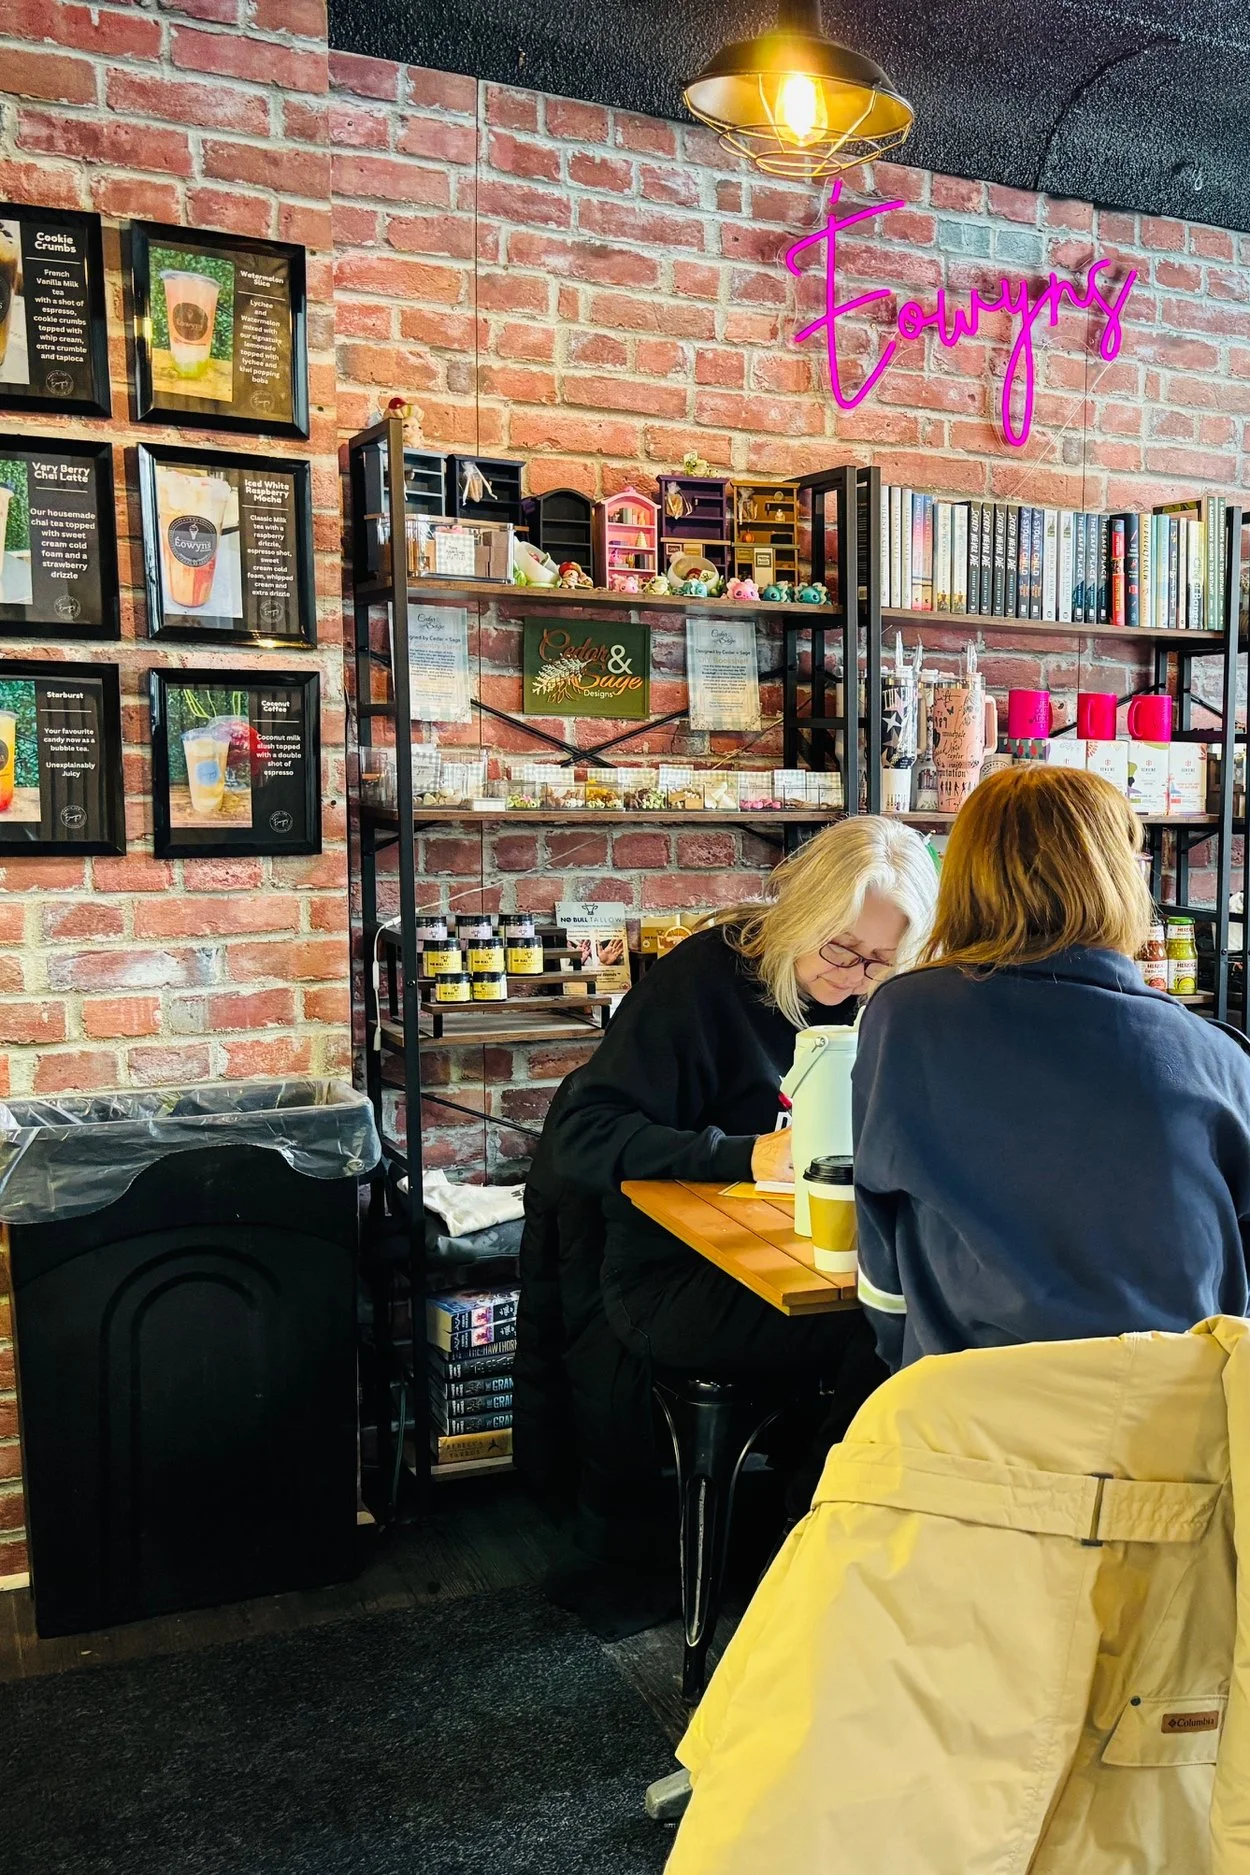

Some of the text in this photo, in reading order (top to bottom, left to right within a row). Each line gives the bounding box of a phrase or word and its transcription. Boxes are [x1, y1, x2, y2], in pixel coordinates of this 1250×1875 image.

[36, 232, 74, 244] Cookie
[35, 241, 76, 253] Crumbs
[44, 269, 70, 278] French
[36, 278, 79, 288] Vanilla Milk
[34, 296, 52, 304] with
[58, 298, 74, 306] shot
[250, 300, 274, 310] Lychee
[42, 306, 77, 316] espresso,
[59, 318, 86, 326] crumbs
[240, 315, 280, 327] Watermelon
[38, 325, 65, 334] topped
[264, 326, 278, 334] with
[40, 334, 84, 344] whip cream,
[36, 343, 88, 354] extra crumble
[244, 341, 276, 352] lemonade
[56, 354, 84, 362] tapioca
[240, 349, 264, 358] topped
[32, 461, 90, 476] Very Berry
[34, 470, 88, 482] Chai Latte
[244, 479, 290, 490] Iced White
[246, 486, 290, 499] Raspberry
[254, 494, 282, 504] Mocha
[30, 508, 96, 520] Our housemade
[250, 514, 287, 524] Classic Milk
[30, 518, 96, 530] chai tea topped
[254, 532, 285, 541] raspberry
[1022, 520, 1030, 550] STOLEN
[41, 540, 88, 550] cream cold
[970, 534, 978, 553] NEVER
[982, 534, 990, 554] NEVER
[996, 535, 1004, 554] NEVER
[1008, 538, 1016, 558] NEVER
[42, 550, 63, 558] foam
[247, 548, 276, 556] espresso
[42, 560, 88, 572] strawberry
[970, 554, 979, 568] DIE
[982, 554, 991, 568] DIE
[995, 556, 1004, 569] DIE
[1008, 558, 1016, 572] DIE
[1020, 551, 1028, 576] CHILD
[1032, 552, 1040, 576] CHILD
[1209, 562, 1214, 570] TO
[1220, 563, 1224, 571] TO
[50, 571, 78, 580] drizzle
[266, 574, 294, 582] whipped
[540, 628, 632, 674] Cedar &
[570, 661, 644, 696] Sage
[46, 690, 84, 699] Starburst
[584, 689, 614, 699] Designs
[261, 700, 290, 708] Coconut
[62, 728, 94, 736] favourite
[44, 736, 65, 744] candy
[46, 762, 96, 770] Unexplainably
[62, 770, 80, 778] Juicy
[1177, 1718, 1214, 1728] Columbia
